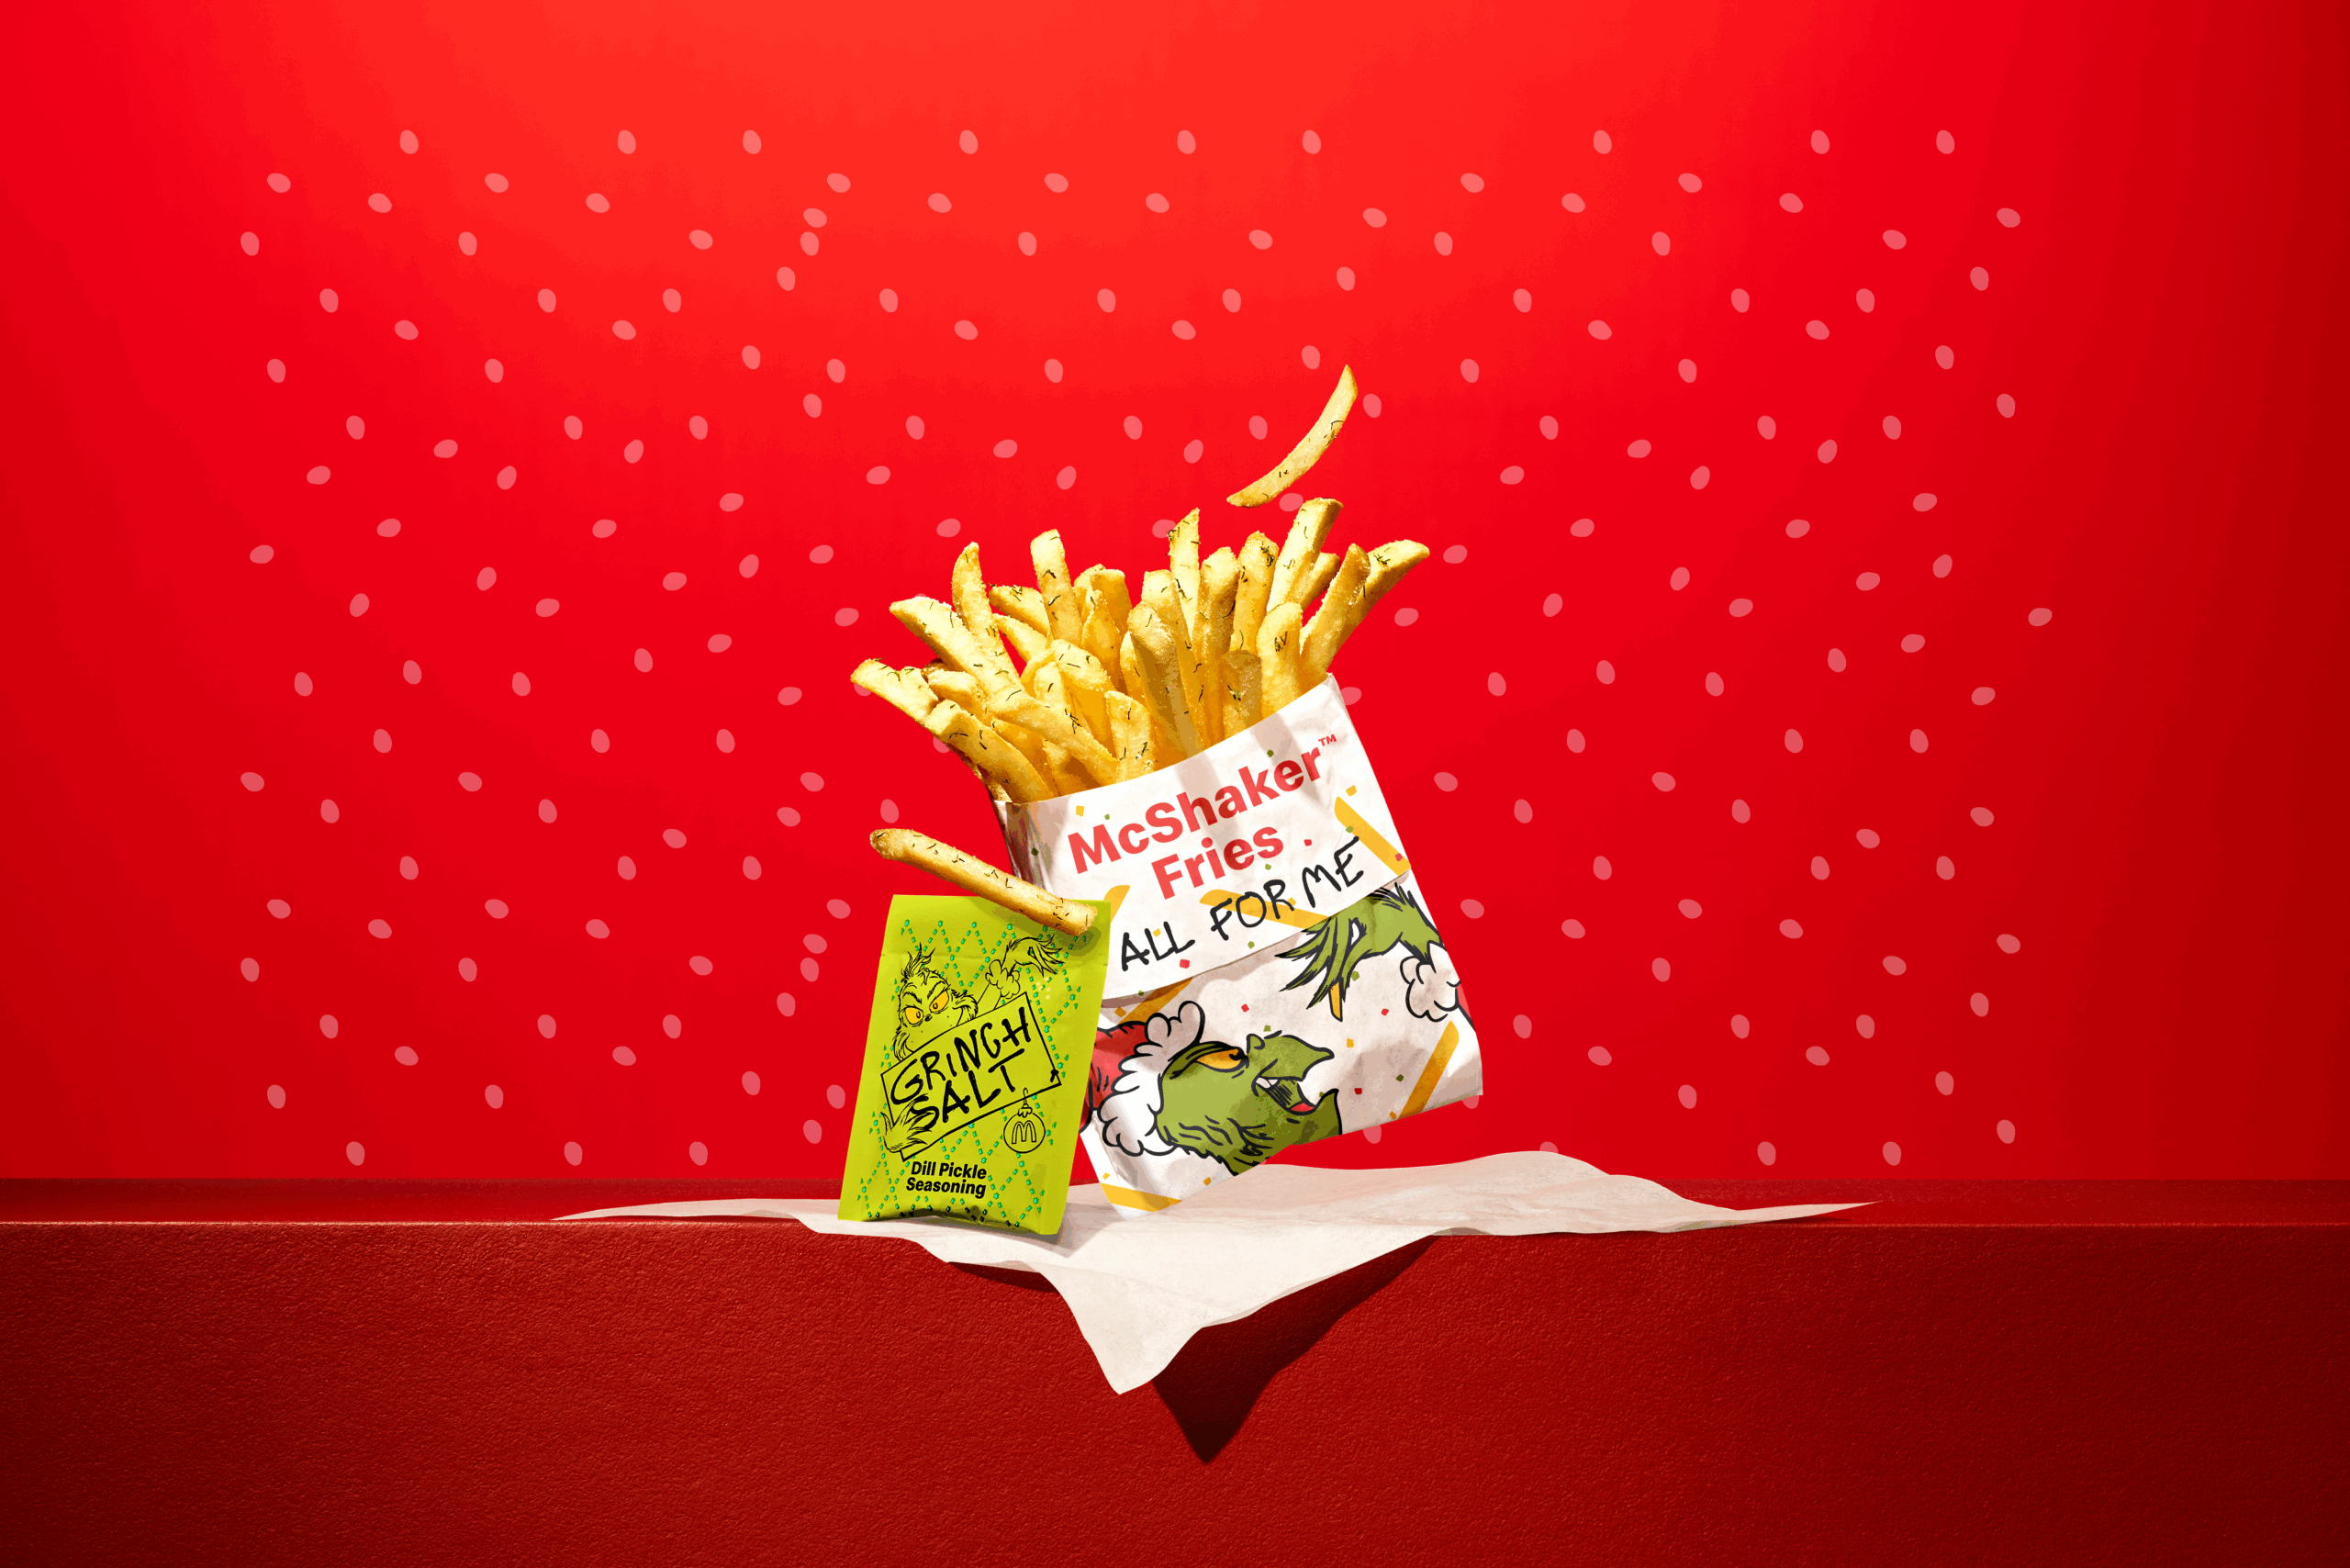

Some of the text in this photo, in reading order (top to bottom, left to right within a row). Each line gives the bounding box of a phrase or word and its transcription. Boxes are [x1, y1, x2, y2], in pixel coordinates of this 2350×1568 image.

[1068, 734, 1337, 874] McShaker™
[1120, 836, 1364, 971] ALL FOR ME
[1151, 826, 1284, 900] Fries
[890, 1006, 1032, 1104] GRINCH
[909, 1048, 1024, 1131] SALT
[906, 1177, 987, 1199] Seasoning
[912, 1161, 987, 1180] Dill Pickle
